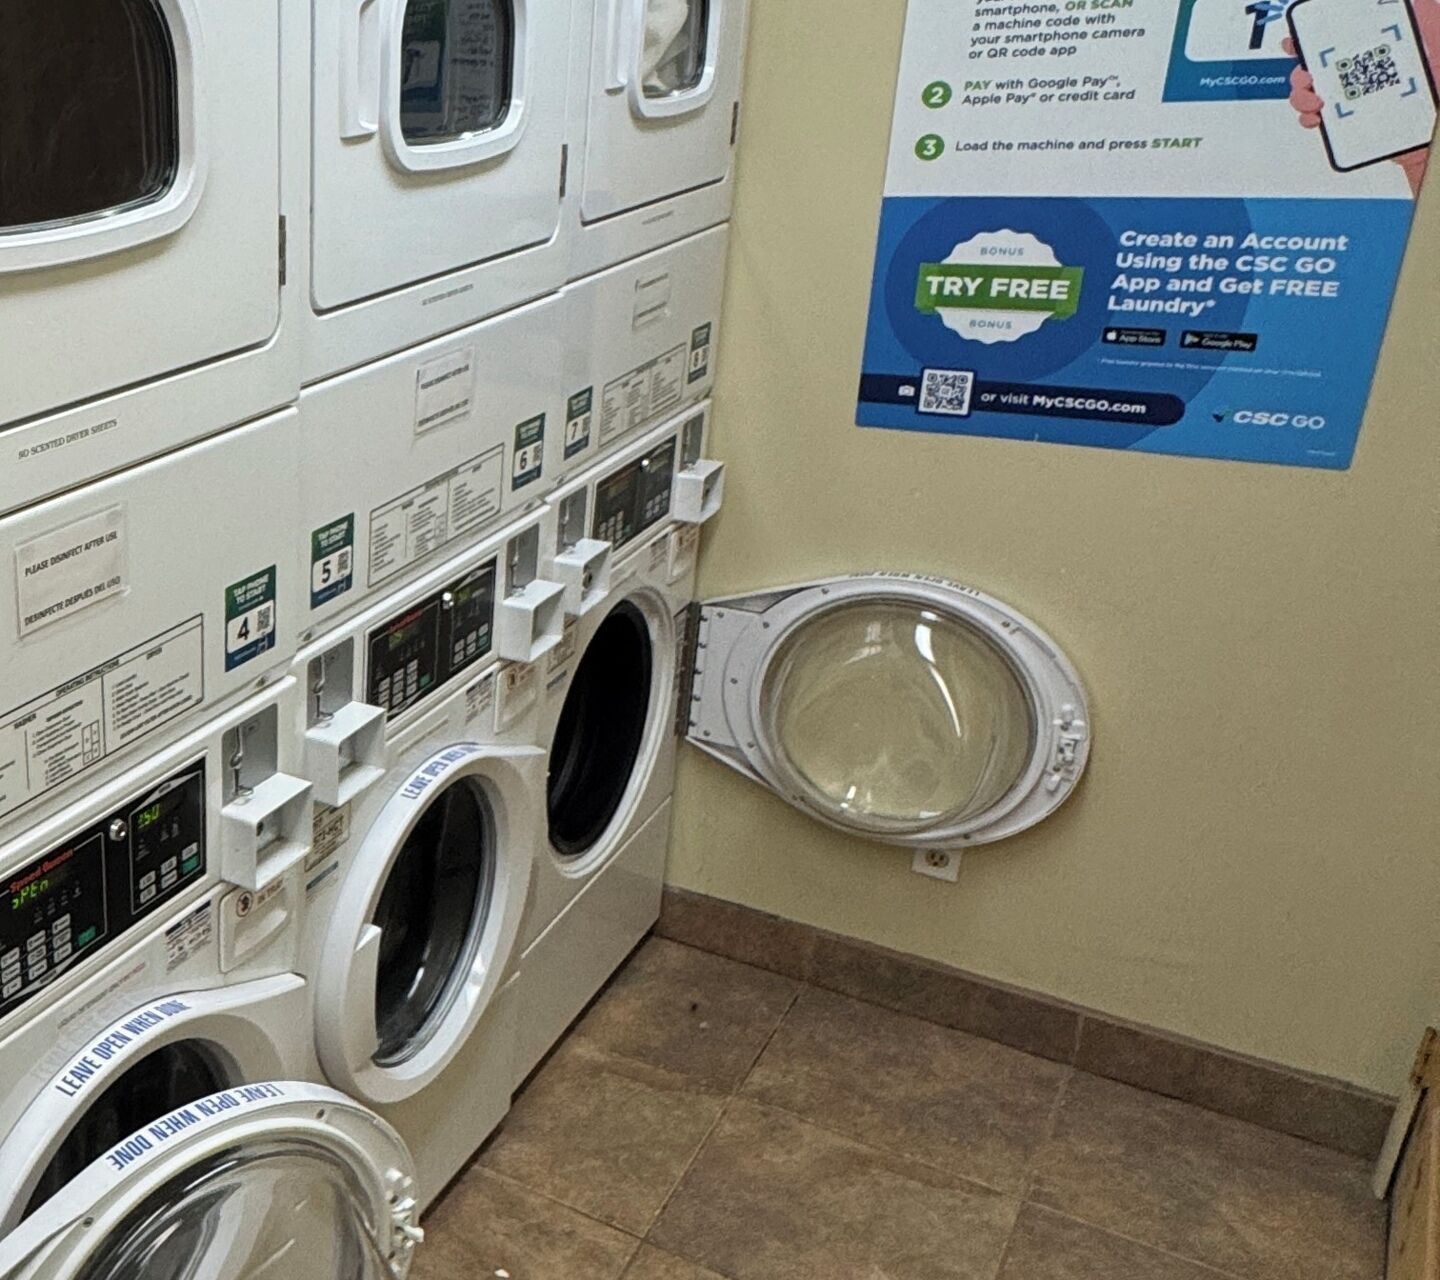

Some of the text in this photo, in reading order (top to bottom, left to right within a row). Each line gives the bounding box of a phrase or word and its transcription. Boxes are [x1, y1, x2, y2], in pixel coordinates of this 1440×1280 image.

[975, 4, 1060, 17] smartphone,
[1065, 1, 1086, 11] OR
[973, 14, 1115, 31] a machine code with
[971, 28, 1145, 47] your smartphone camera
[968, 45, 1077, 59] or QR code app
[964, 80, 992, 92] PAY
[995, 78, 1024, 89] with
[1028, 77, 1078, 90] Google
[962, 93, 1001, 106] Apple
[1039, 92, 1052, 102] or
[1058, 90, 1098, 102] credit
[1103, 89, 1136, 100] card
[956, 137, 1203, 152] Load the machine and press START
[1120, 231, 1349, 251] Create an Account
[980, 247, 1024, 256] BONUS
[1116, 252, 1335, 274] Using the CSC GO
[926, 276, 1071, 300] TRY FREE
[1111, 274, 1340, 297] App and Get FREE
[969, 320, 1012, 329] BONUS
[981, 392, 1147, 414] or visit MyCSCGO.com
[1232, 410, 1325, 430] CSC GO
[321, 560, 331, 584] 5
[237, 617, 250, 640] 4
[55, 1056, 102, 1097] LEAVE
[92, 1030, 133, 1061] OPEN
[121, 1010, 164, 1036] WHEN
[105, 1083, 285, 1171] LEAVE OPEN WHEN DONE
